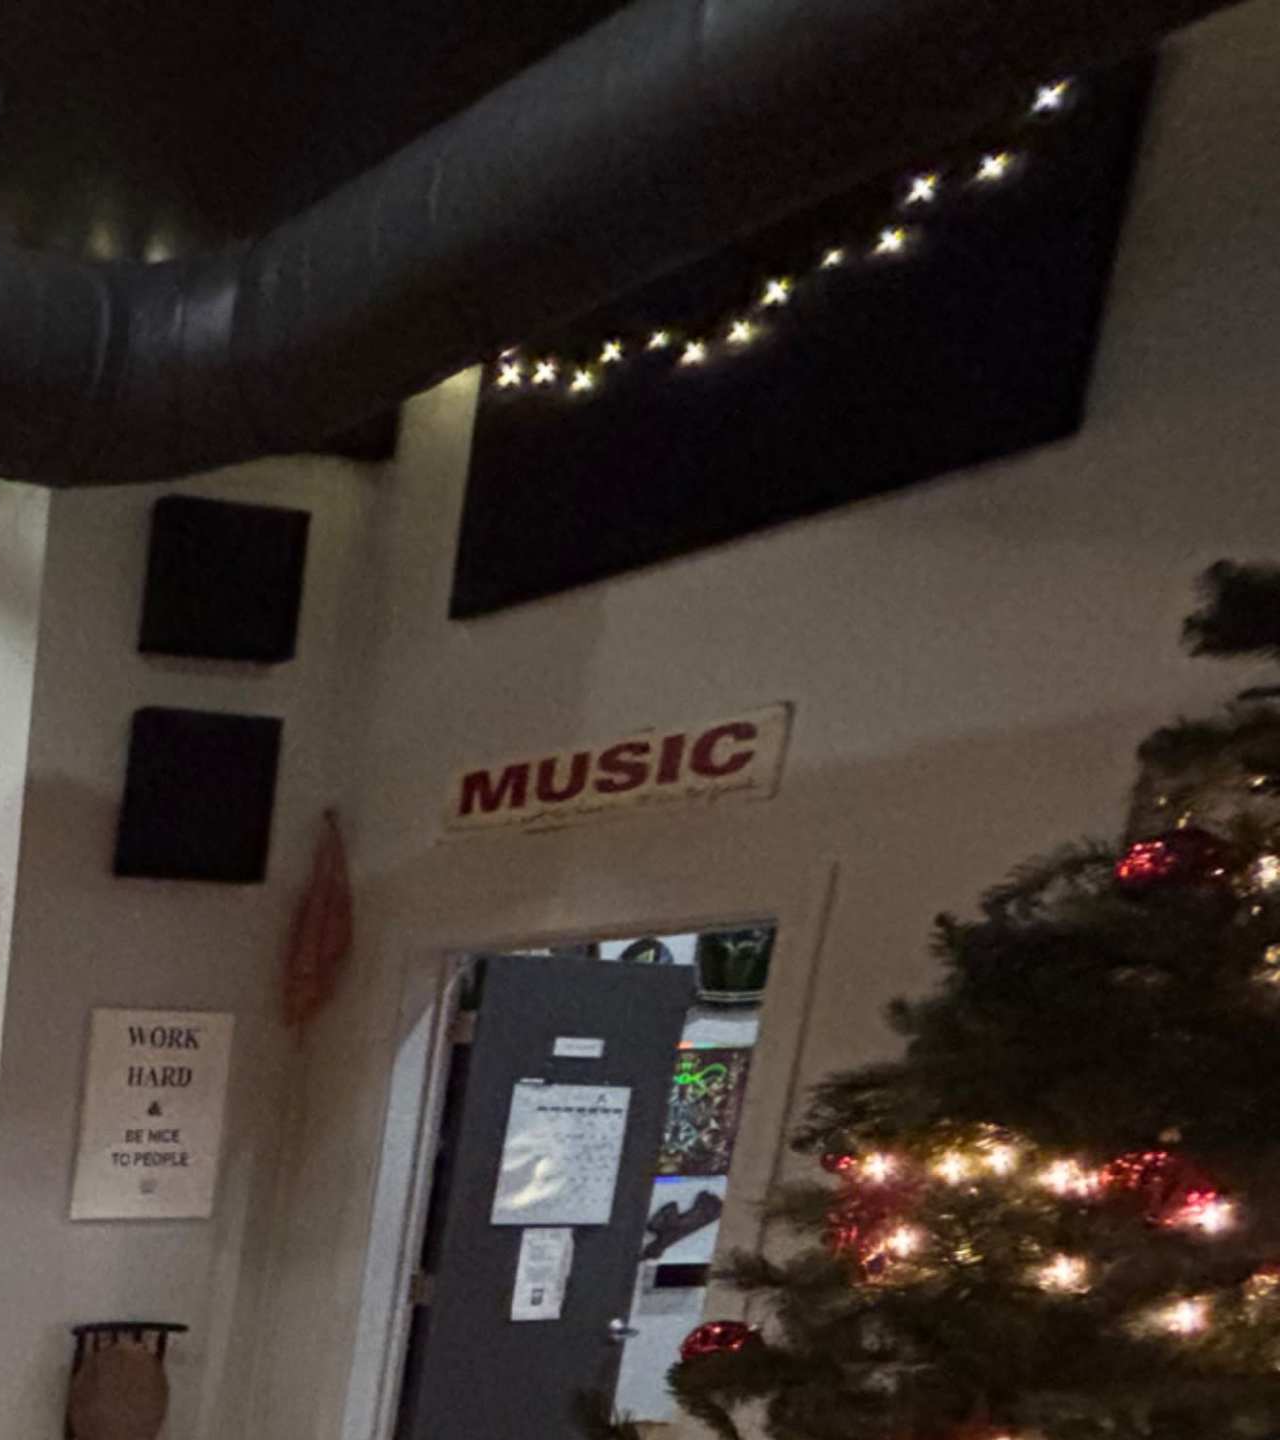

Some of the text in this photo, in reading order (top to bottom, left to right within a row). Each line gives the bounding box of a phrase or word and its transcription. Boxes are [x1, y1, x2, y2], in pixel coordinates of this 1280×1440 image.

[458, 721, 758, 817] MUSIC
[128, 1026, 200, 1050] WORK
[127, 1066, 193, 1088] HARD
[146, 1100, 163, 1117] &
[125, 1129, 181, 1144] BE NICE
[111, 1151, 190, 1168] TO PEOPLE
